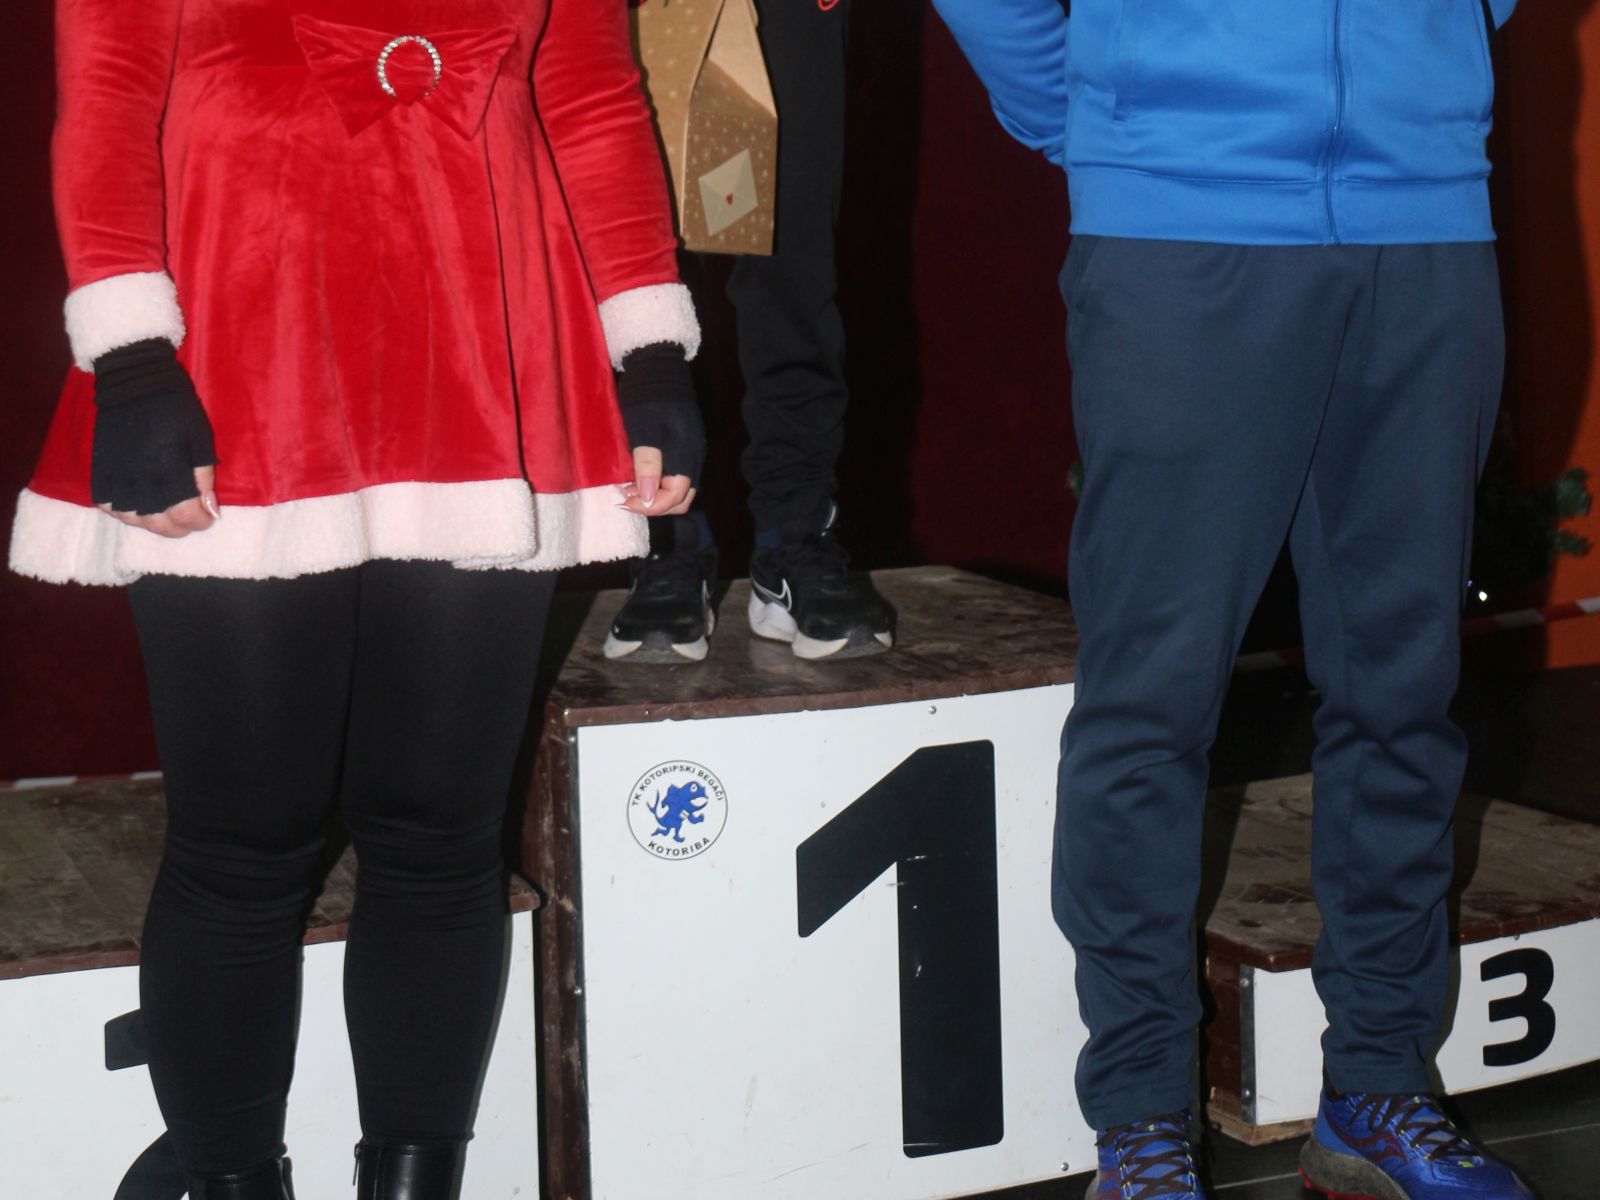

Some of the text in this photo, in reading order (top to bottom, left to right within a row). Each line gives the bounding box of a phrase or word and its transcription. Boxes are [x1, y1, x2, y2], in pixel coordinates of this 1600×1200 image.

[631, 764, 725, 806] TK KOTORIPSKI BEGAČI
[648, 836, 711, 857] KOTORIBA
[796, 739, 1005, 1159] 1
[1480, 947, 1557, 1067] 3
